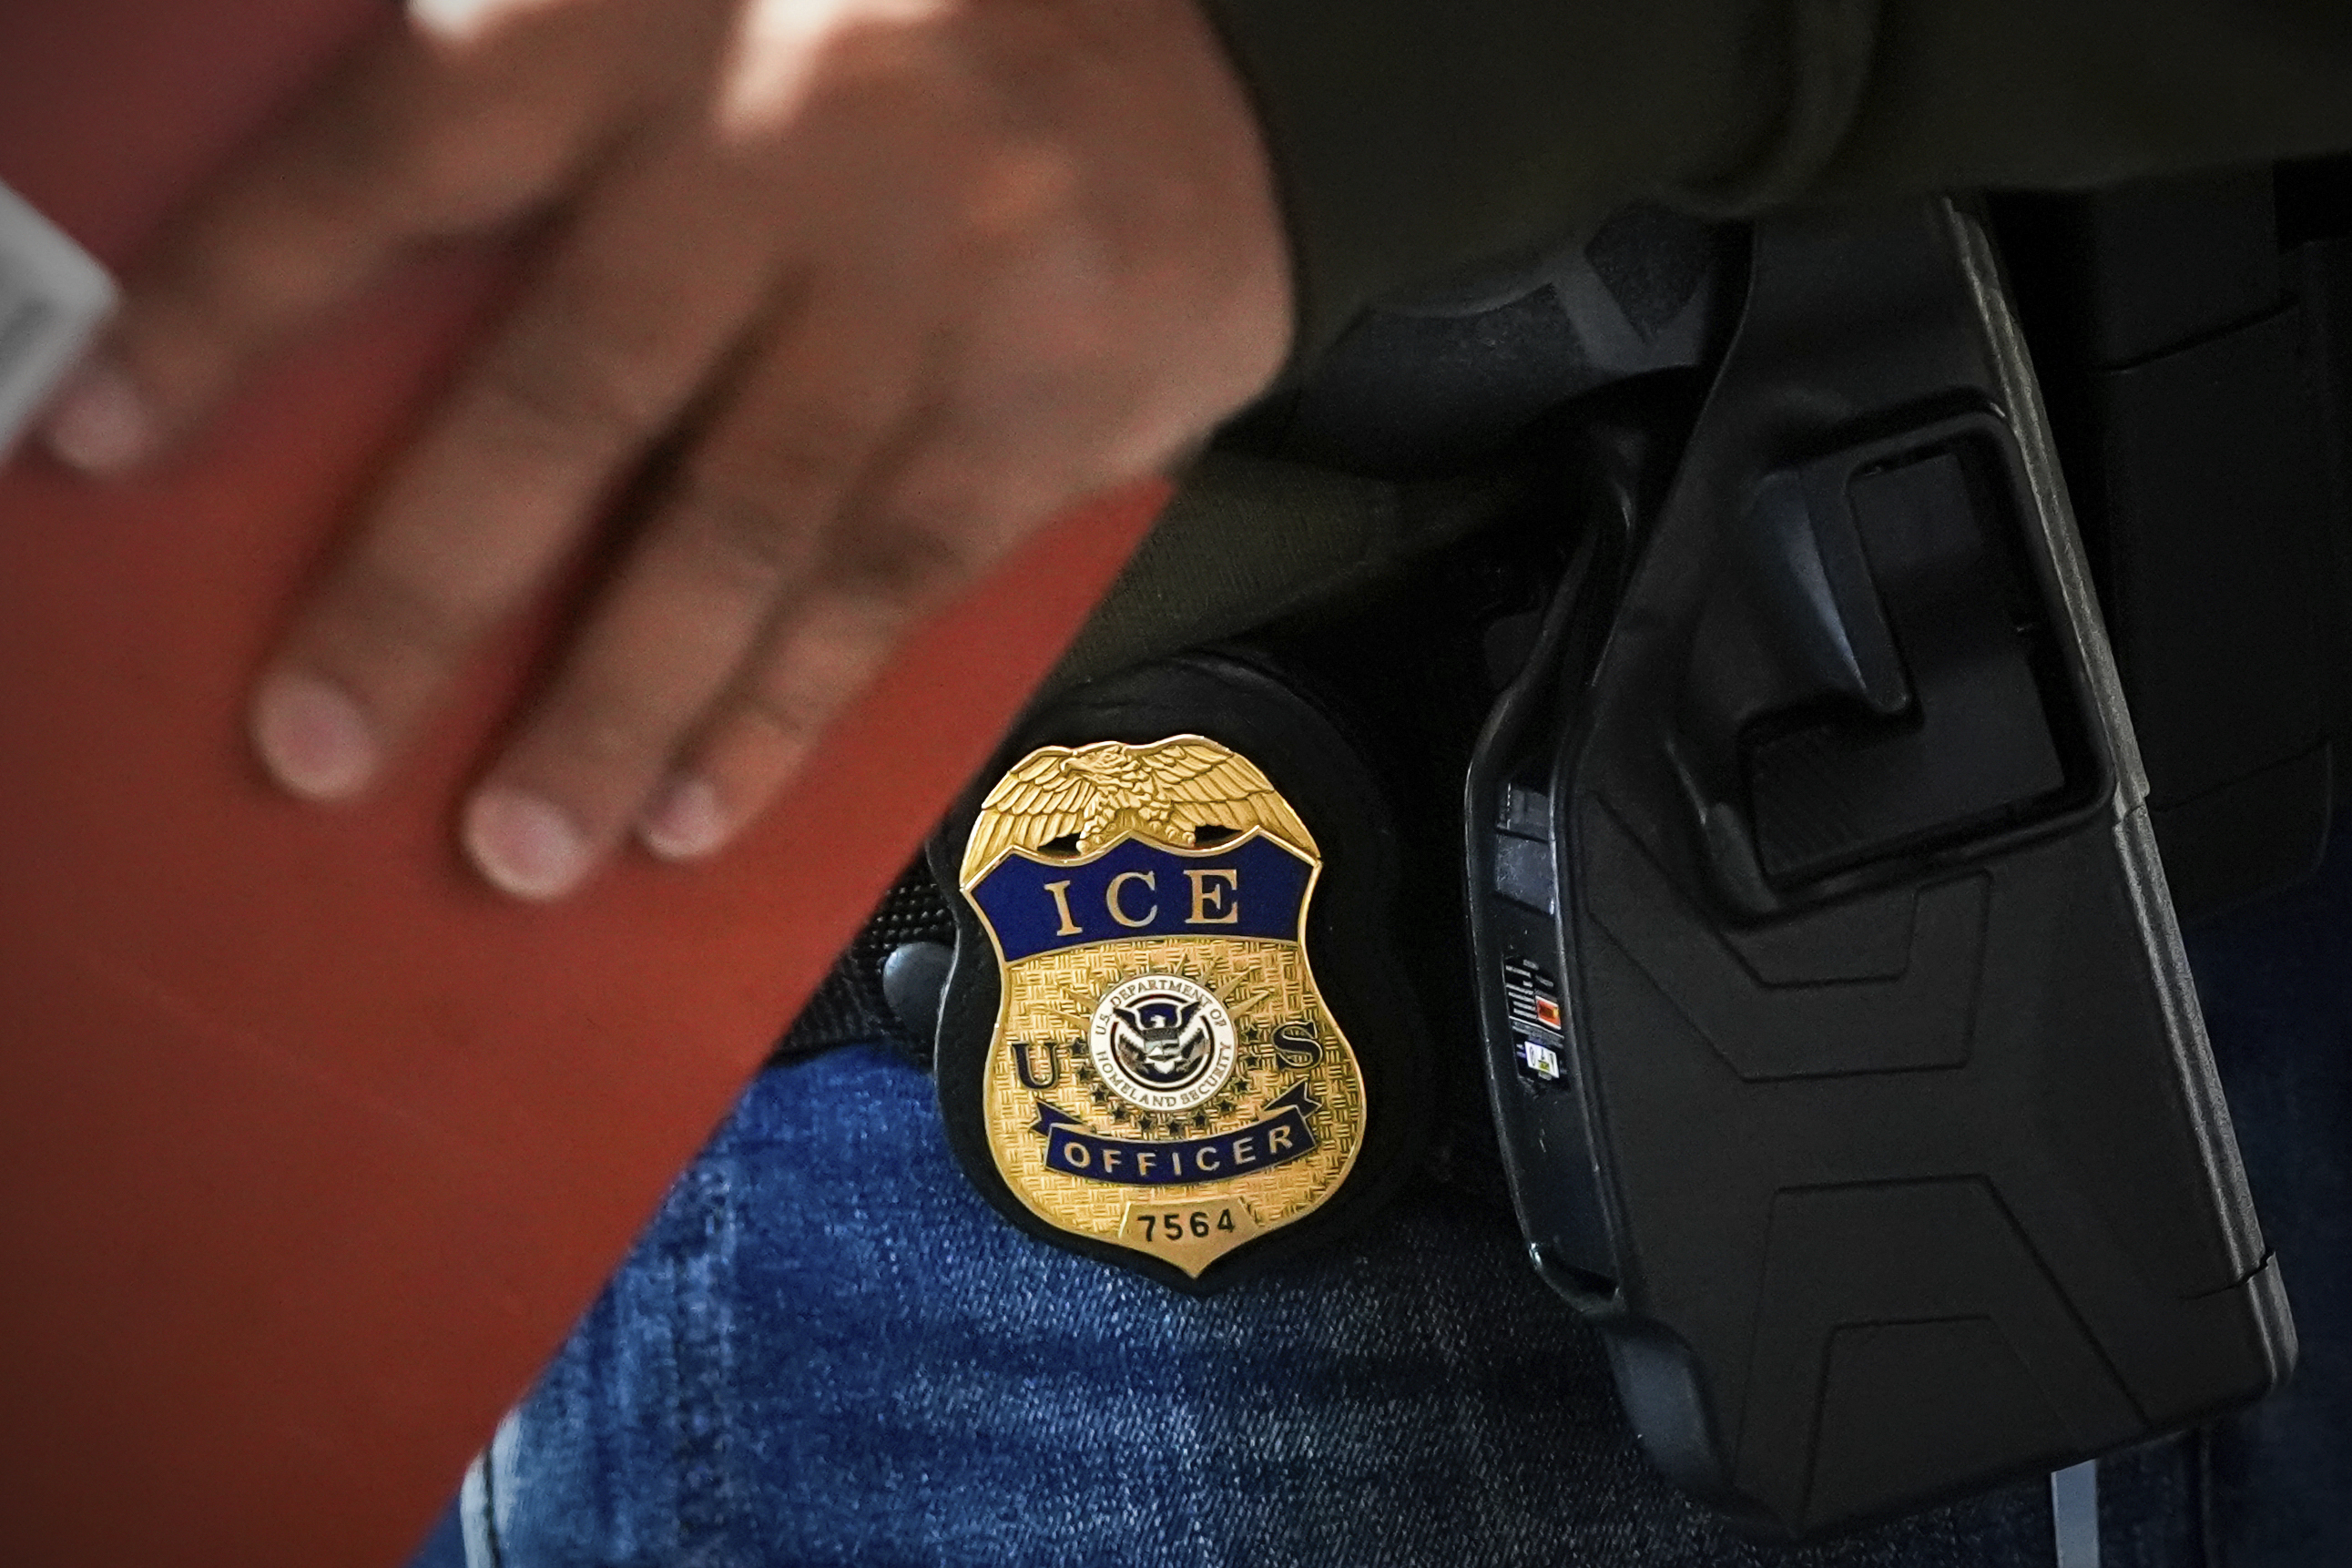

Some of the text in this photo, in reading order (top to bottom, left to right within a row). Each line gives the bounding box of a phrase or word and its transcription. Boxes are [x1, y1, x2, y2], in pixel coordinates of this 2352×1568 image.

[1044, 869, 1238, 936] ICE
[1110, 979, 1213, 1008] DEPARTMENT
[1209, 1008, 1227, 1028] OF
[1011, 1021, 1325, 1090] U S
[1095, 1041, 1232, 1108] HOMELAND SECURITY
[1064, 1125, 1294, 1176] OFFICER
[1137, 1207, 1237, 1242] 7564
